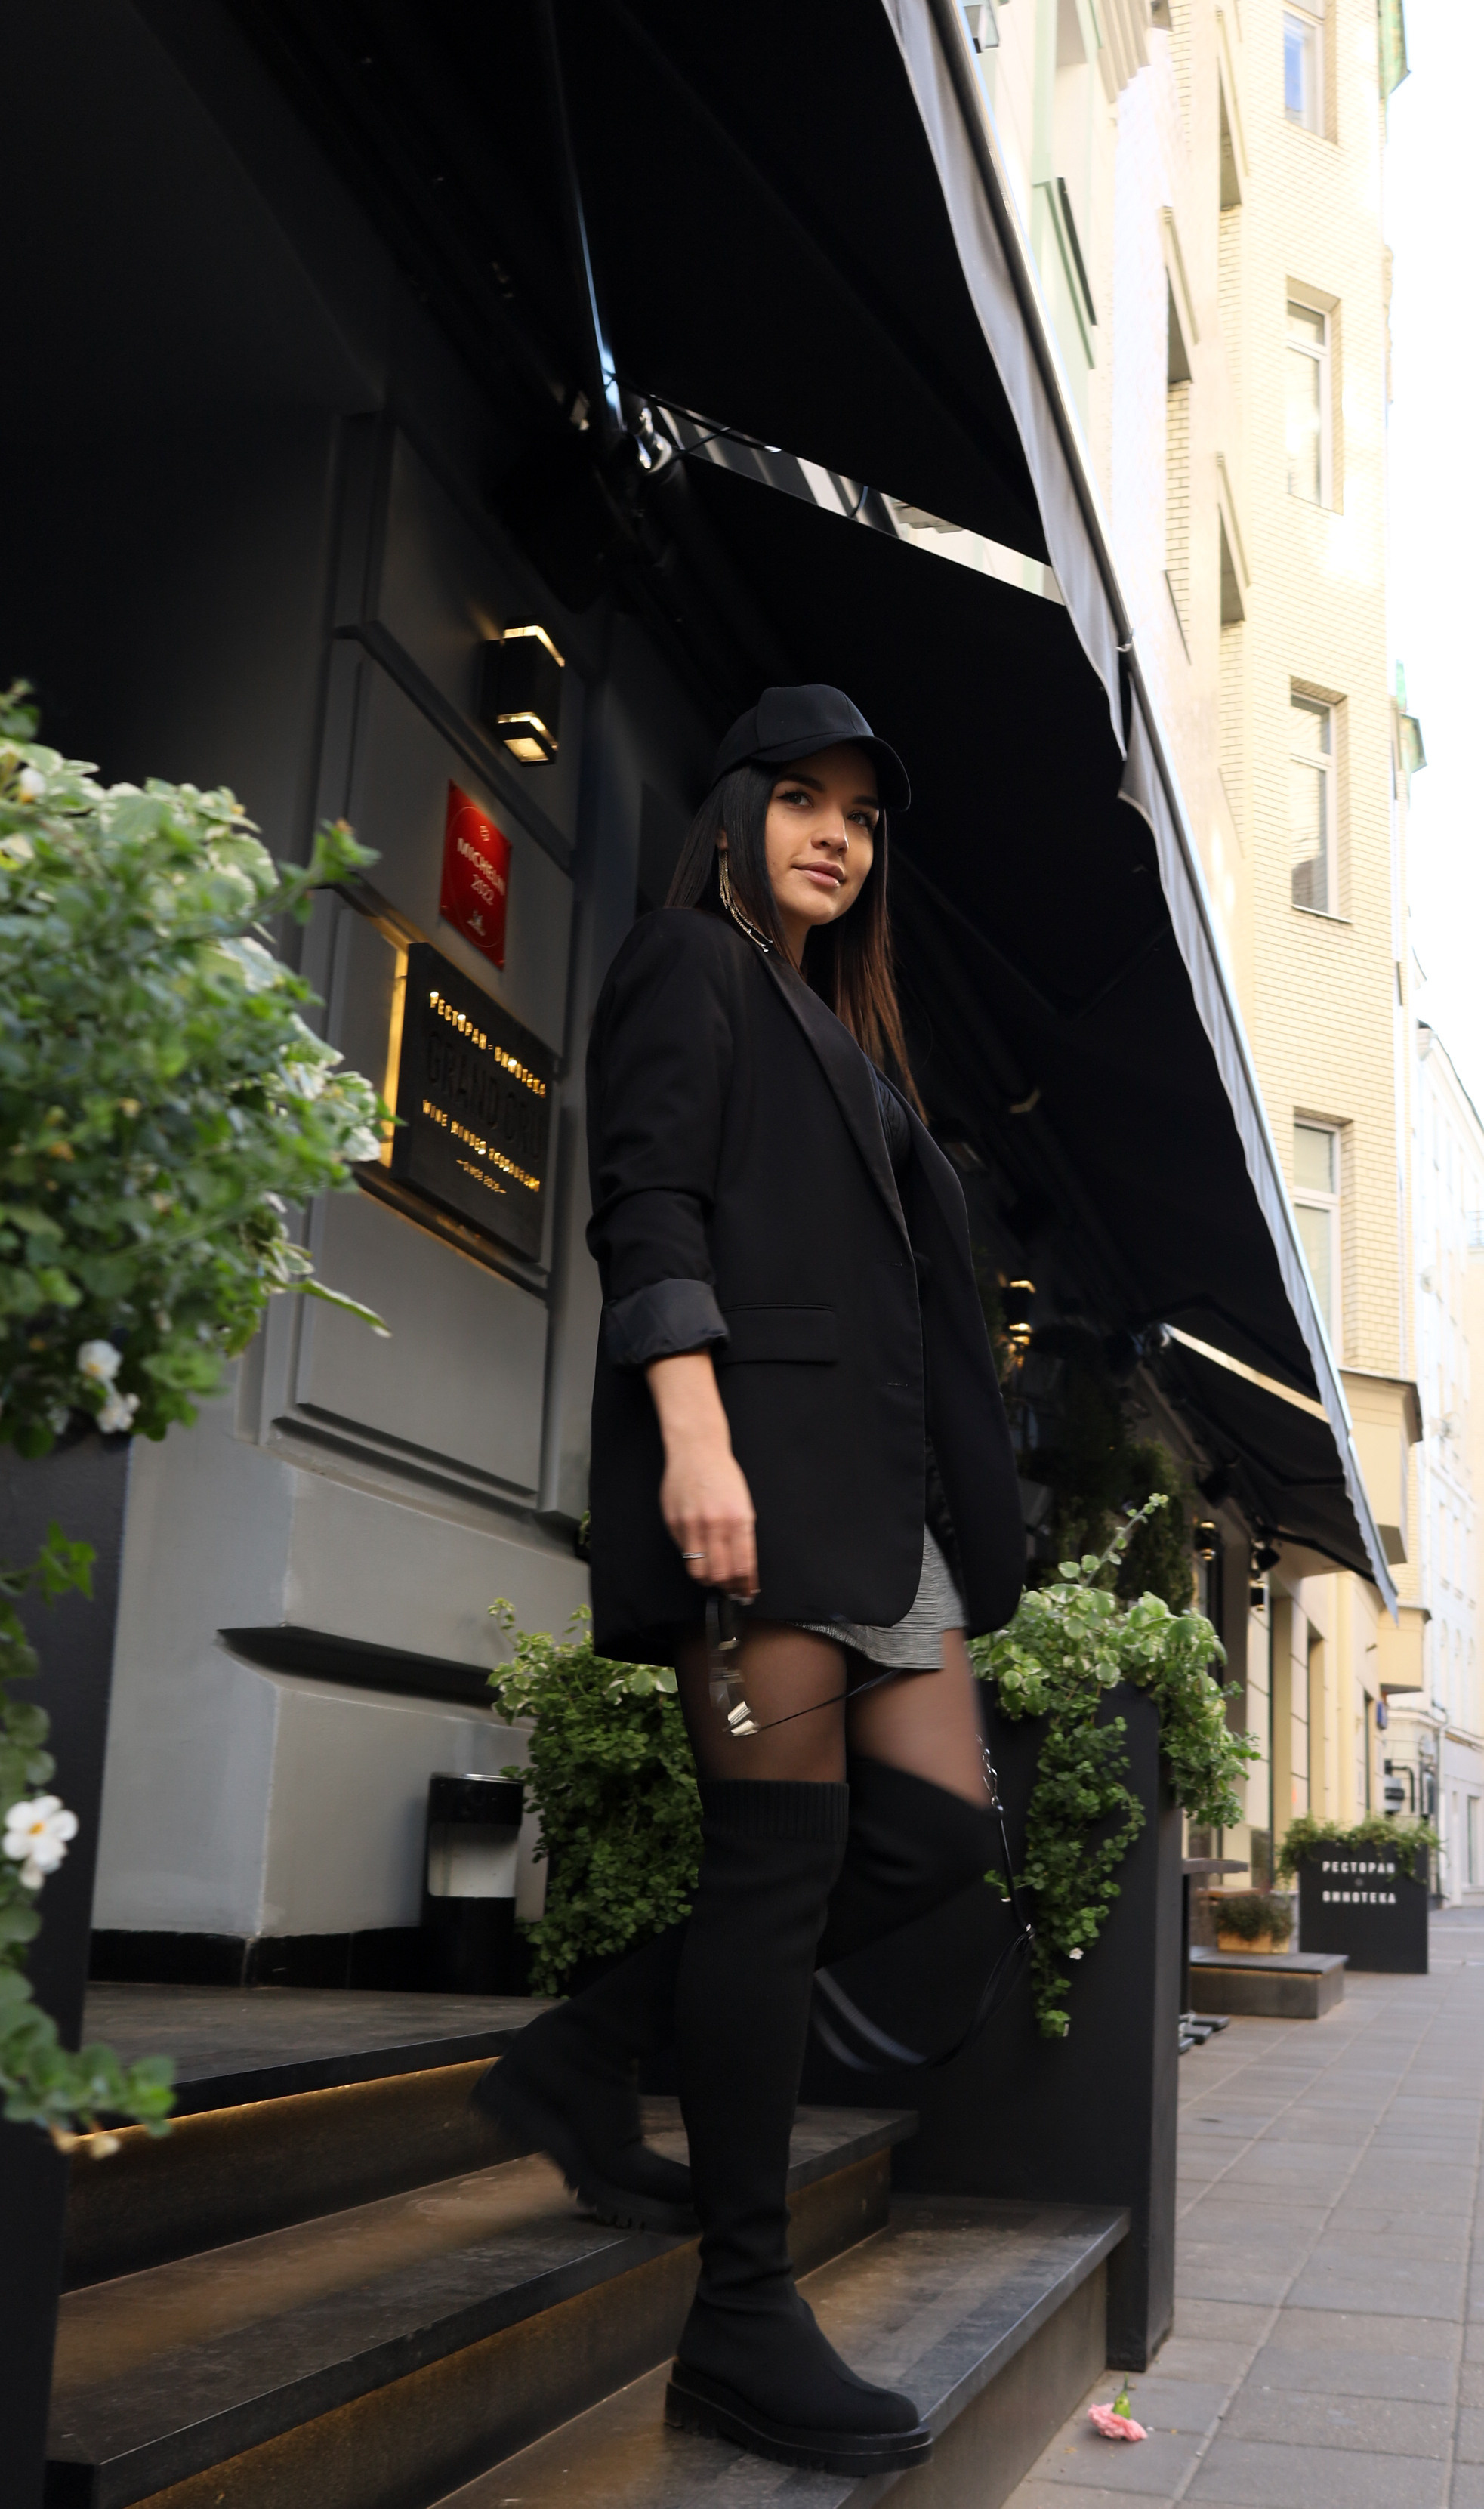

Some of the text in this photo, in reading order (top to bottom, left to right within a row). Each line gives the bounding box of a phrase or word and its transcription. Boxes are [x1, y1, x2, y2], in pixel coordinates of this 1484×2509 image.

[457, 838, 505, 896] MICHELIN
[470, 874, 495, 905] 2022
[430, 991, 487, 1050] РЕСТОРАН
[427, 1030, 498, 1130] GRAND
[1322, 1861, 1395, 1873] РЕСТОРАН
[1322, 1891, 1396, 1903] ВИНОТЕКА
